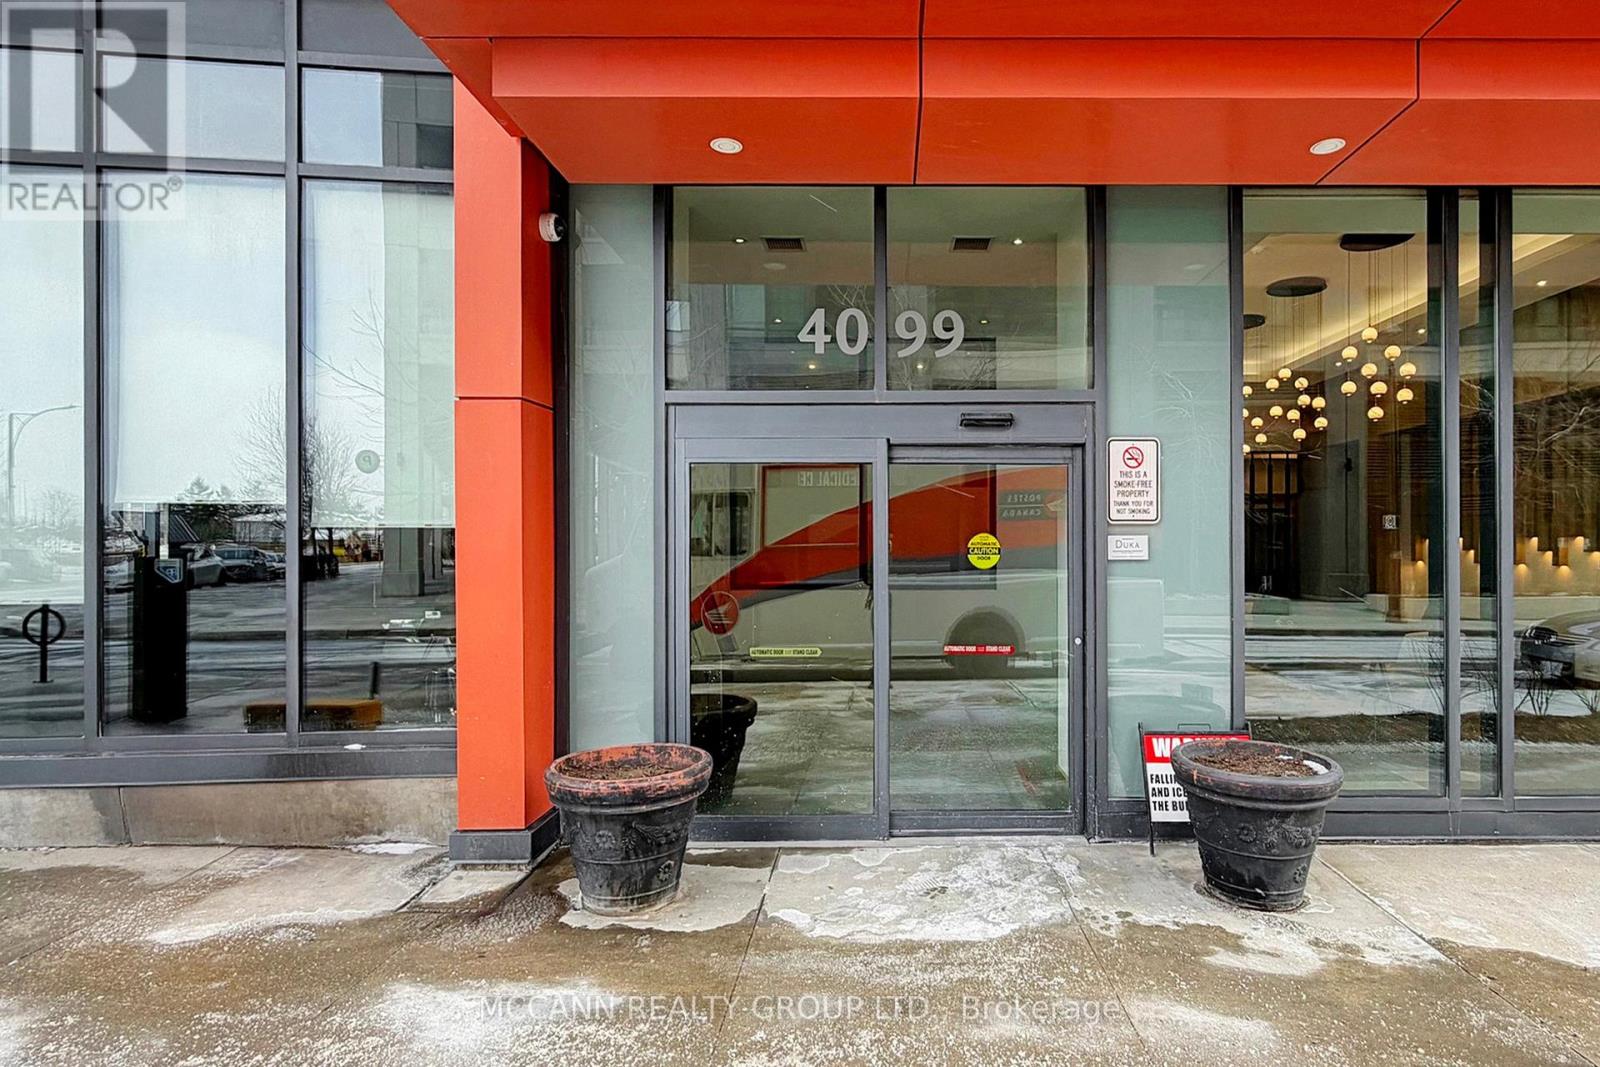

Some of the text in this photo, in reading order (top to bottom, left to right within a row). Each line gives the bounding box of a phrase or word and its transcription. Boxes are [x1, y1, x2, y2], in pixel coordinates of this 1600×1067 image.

[1119, 470, 1148, 479] THIS IS A
[1113, 480, 1153, 489] SMOKE-FREE
[1116, 490, 1150, 498] PROPERTY
[1151, 786, 1170, 798] AND
[1152, 800, 1170, 812] THE
